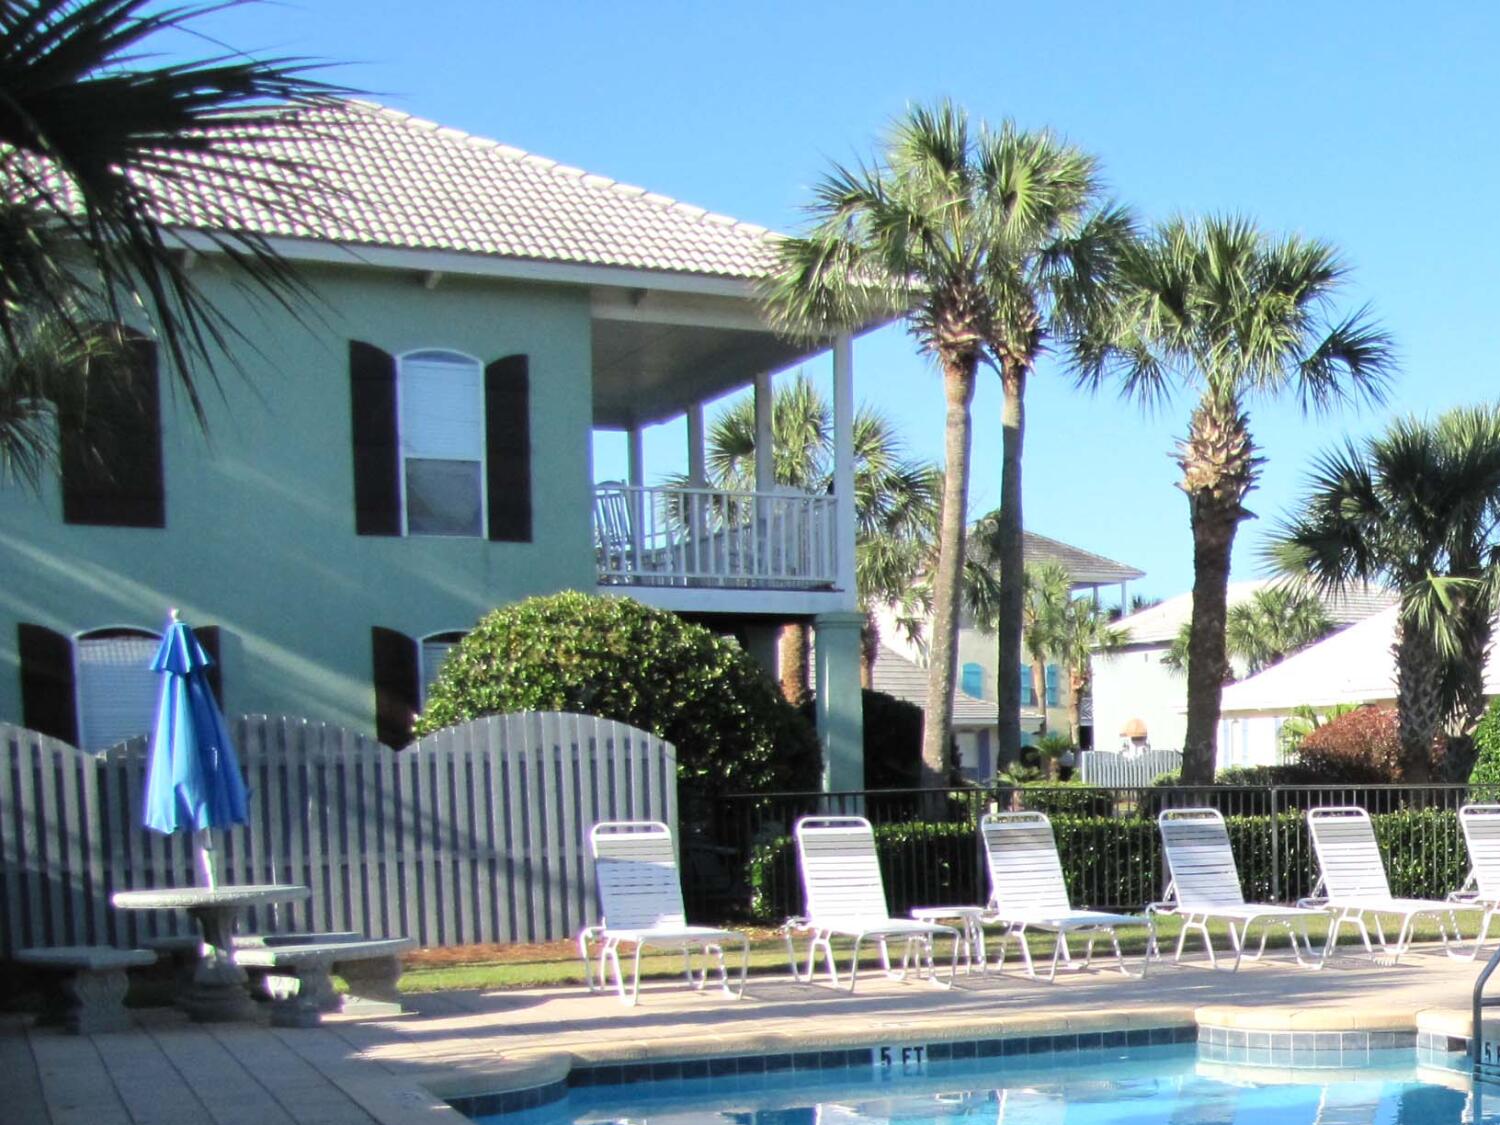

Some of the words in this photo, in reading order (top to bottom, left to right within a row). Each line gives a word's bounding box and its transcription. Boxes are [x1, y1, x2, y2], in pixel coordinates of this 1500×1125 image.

[880, 1046, 892, 1066] 5
[902, 1046, 924, 1064] FT
[1485, 1042, 1491, 1063] 5
